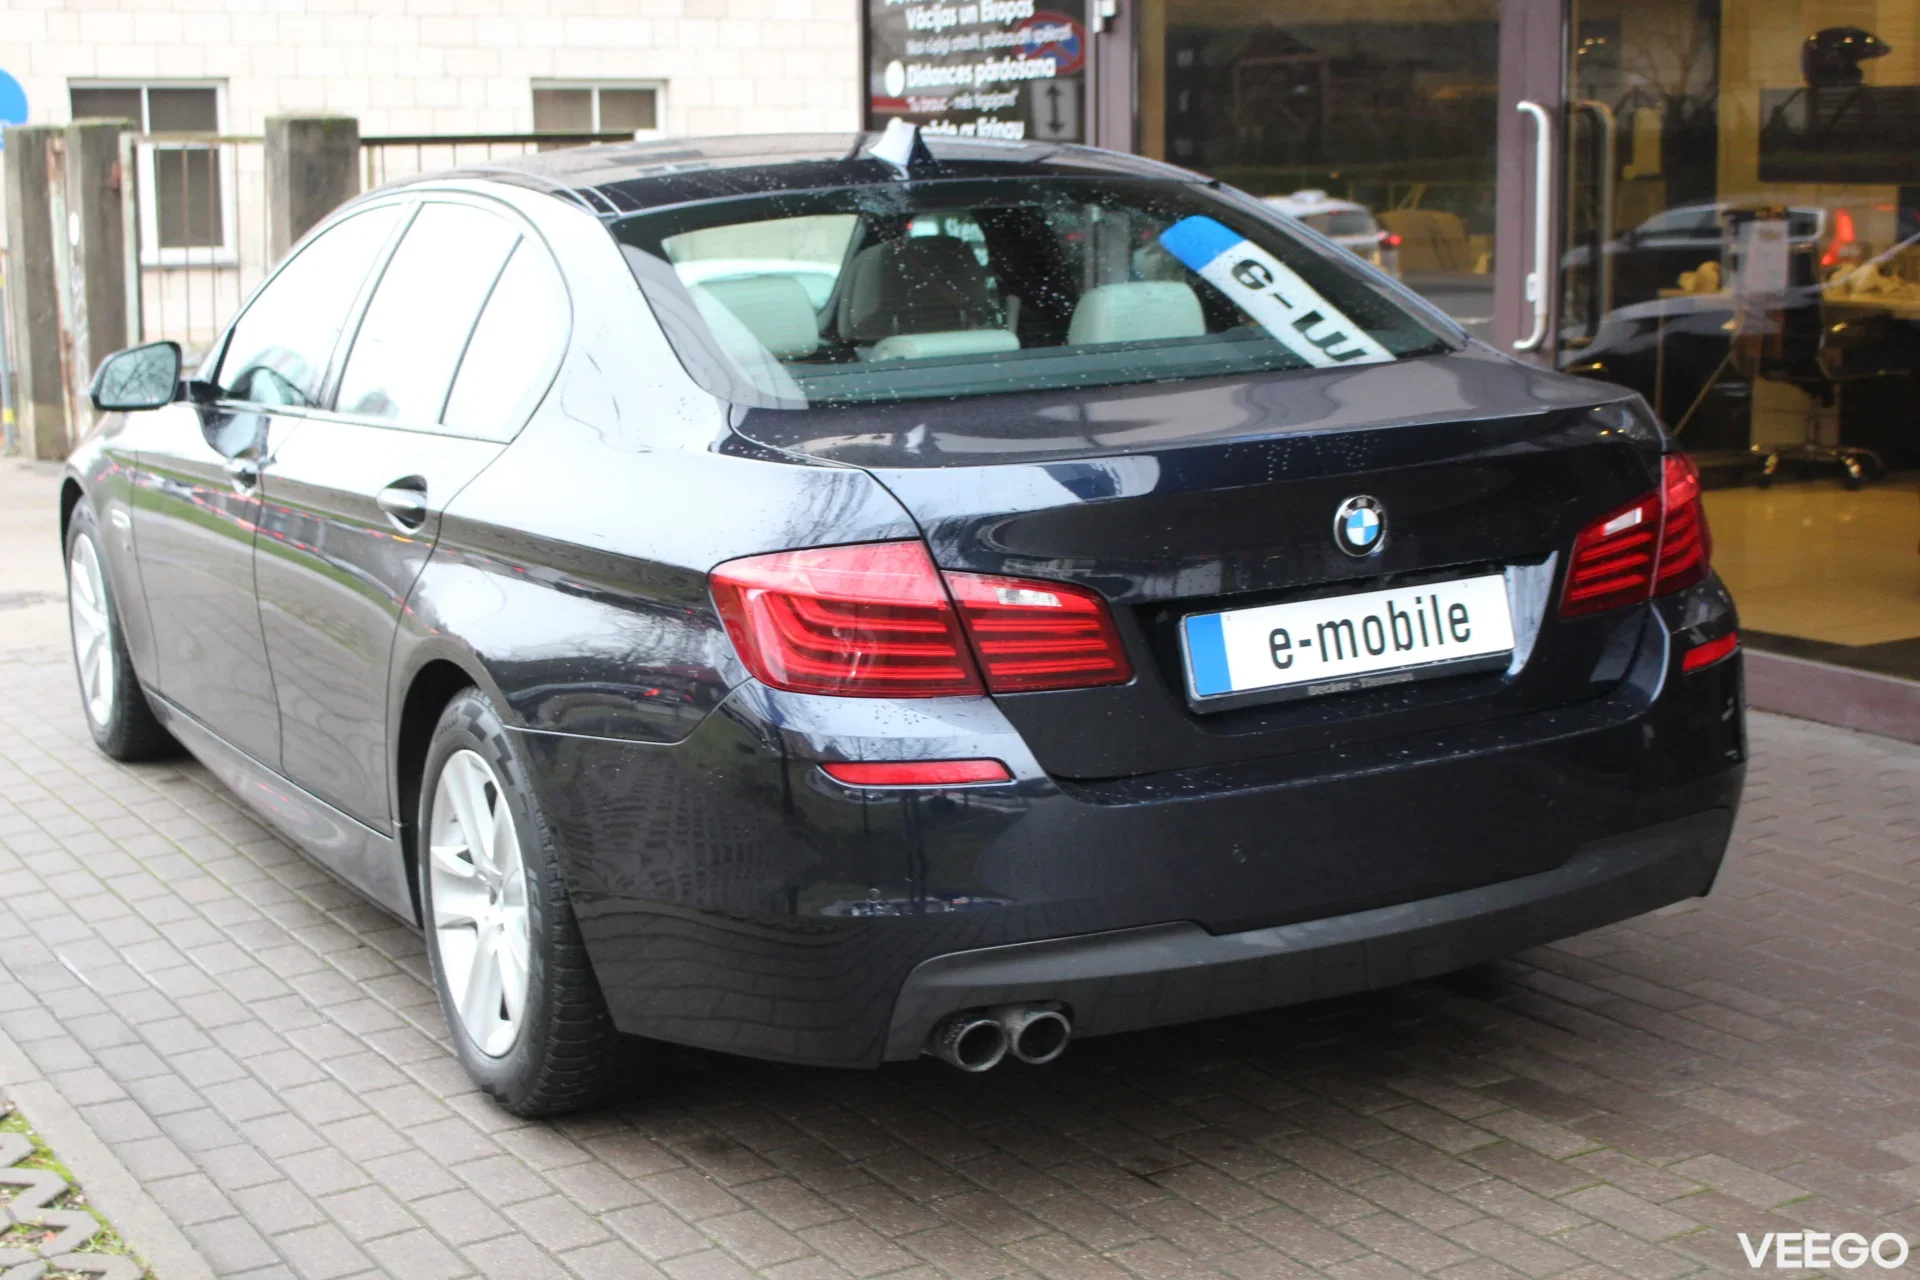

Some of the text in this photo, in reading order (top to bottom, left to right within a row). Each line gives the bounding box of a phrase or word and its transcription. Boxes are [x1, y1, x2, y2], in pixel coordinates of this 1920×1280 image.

[905, 4, 957, 33] Vācijas
[959, 4, 978, 25] un
[907, 54, 1056, 88] Distances pārdošana
[1268, 594, 1471, 670] e-mobile
